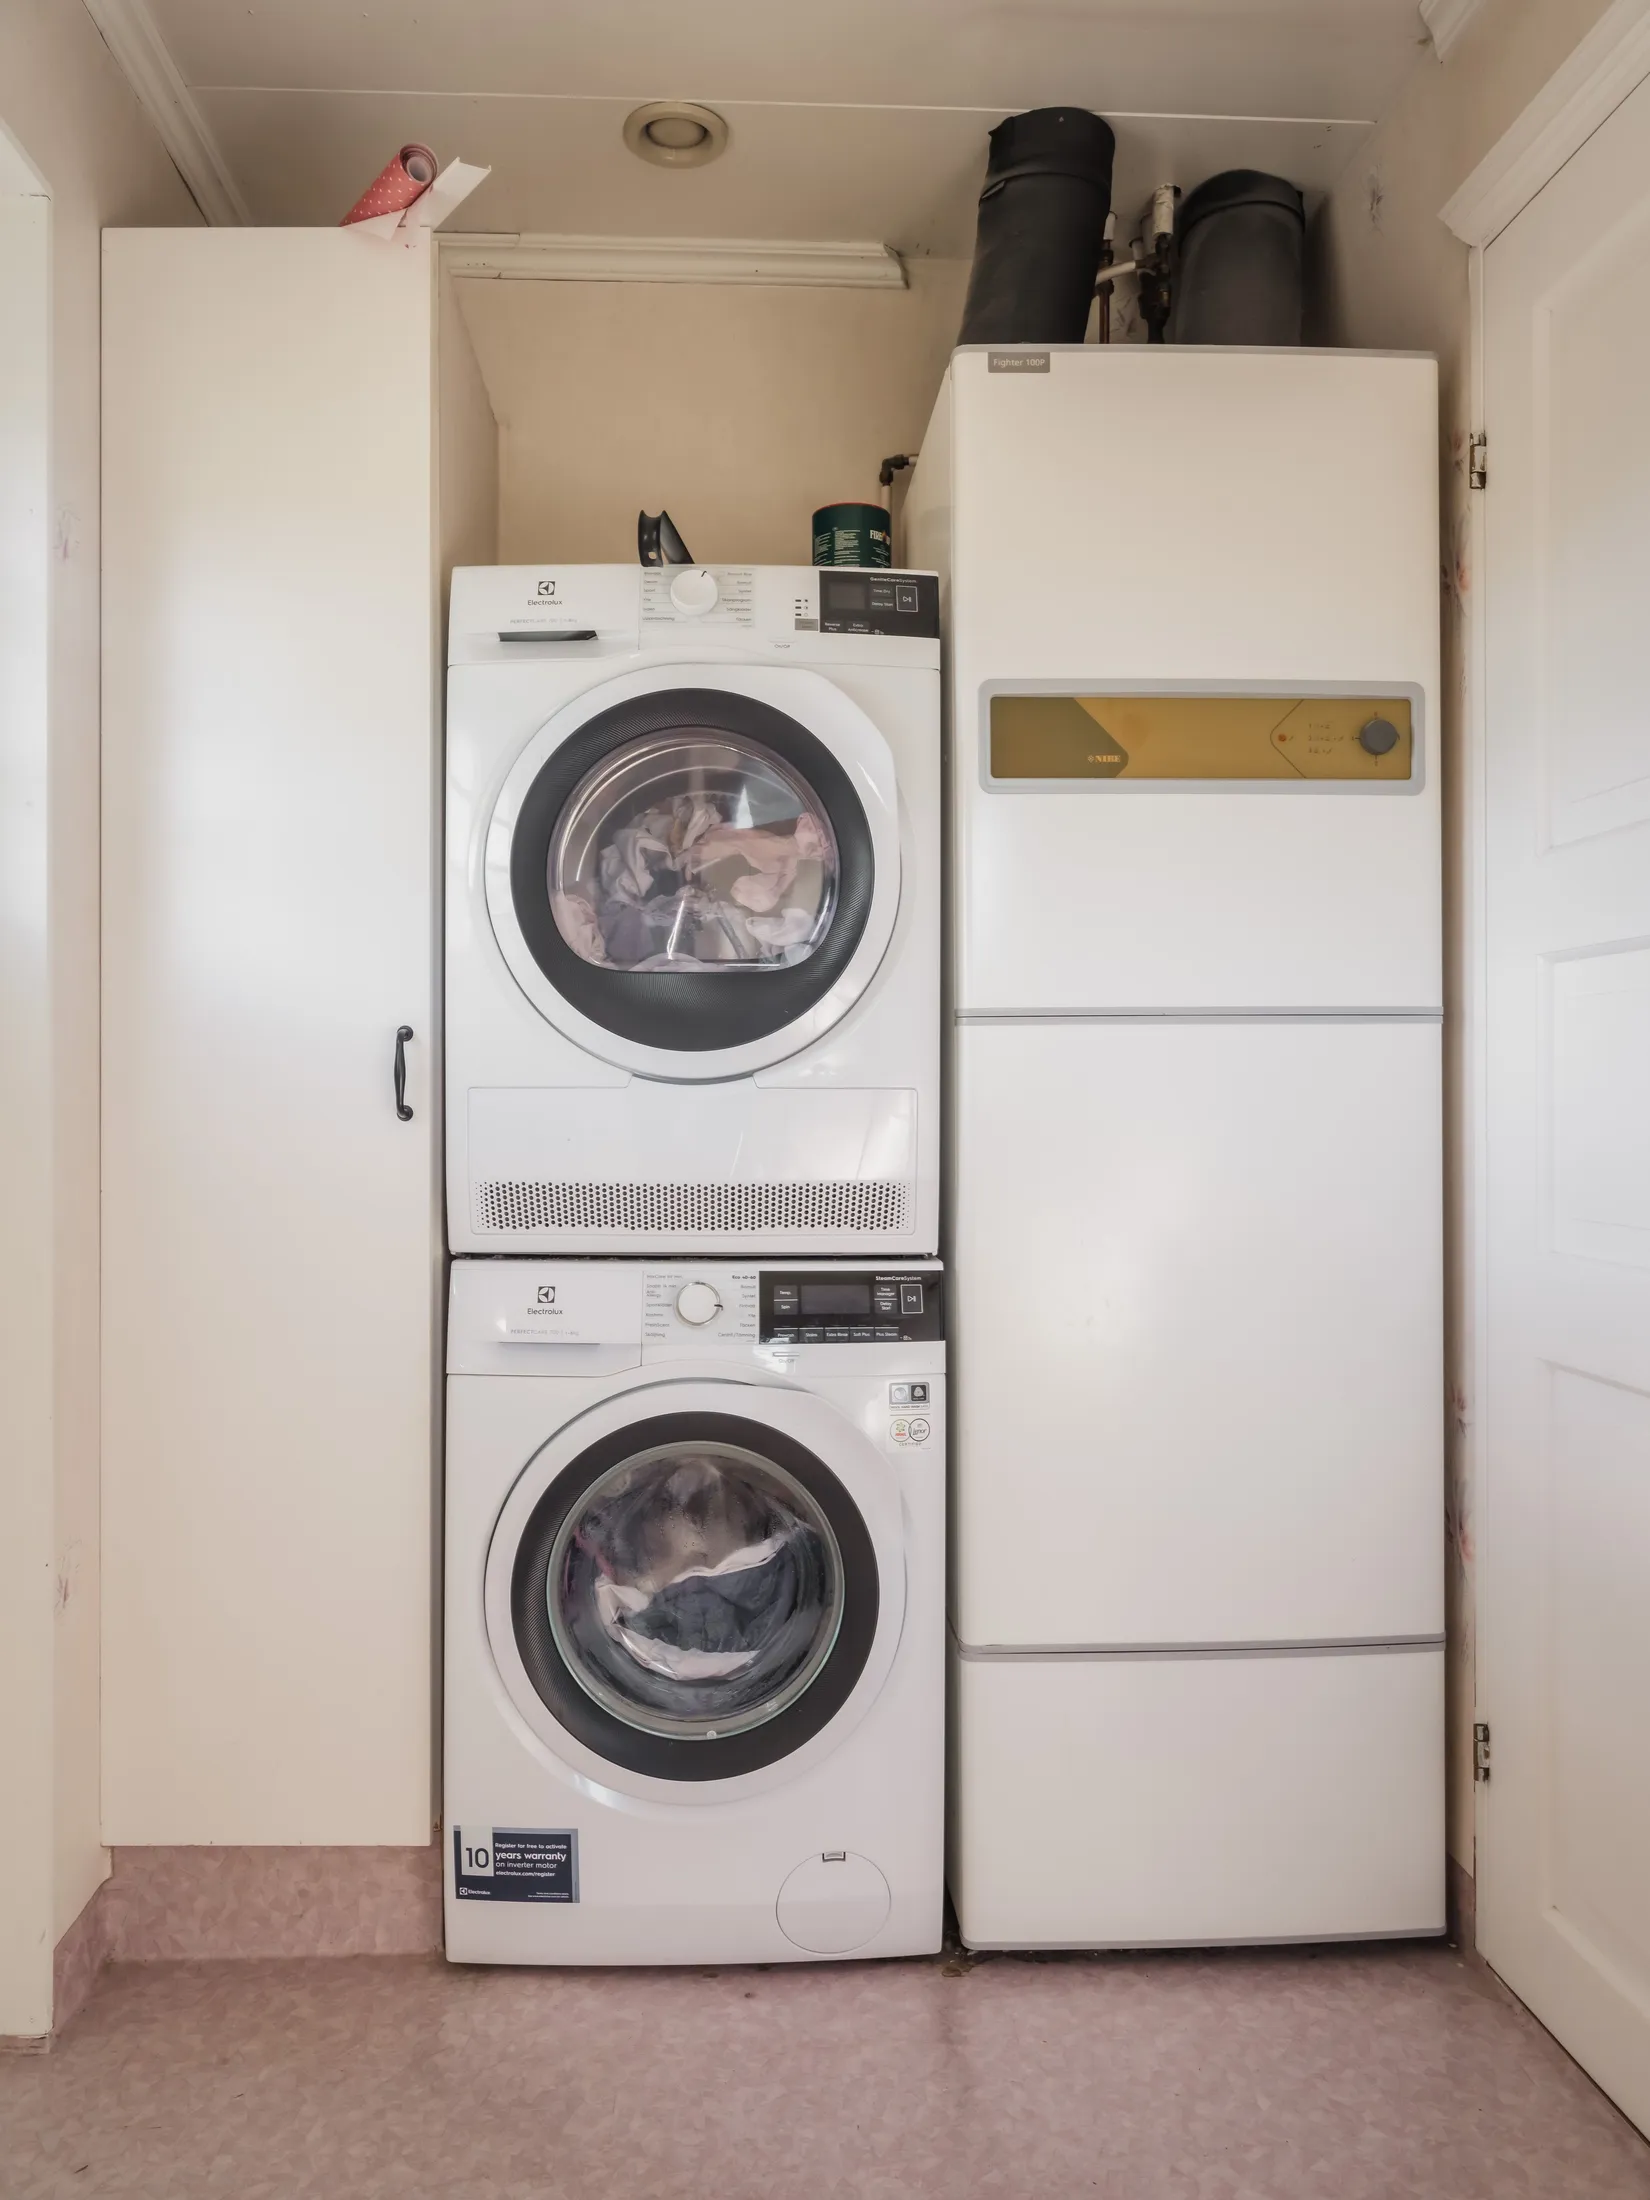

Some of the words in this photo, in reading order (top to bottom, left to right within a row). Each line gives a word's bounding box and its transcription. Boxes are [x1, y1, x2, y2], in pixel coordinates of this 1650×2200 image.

[993, 358, 1023, 368] Fighter
[1026, 358, 1045, 366] 100P
[1095, 755, 1121, 763] NIBE
[465, 1848, 490, 1869] 10
[495, 1852, 521, 1860] years
[523, 1853, 567, 1862] warranty
[507, 1861, 534, 1869] inverter
